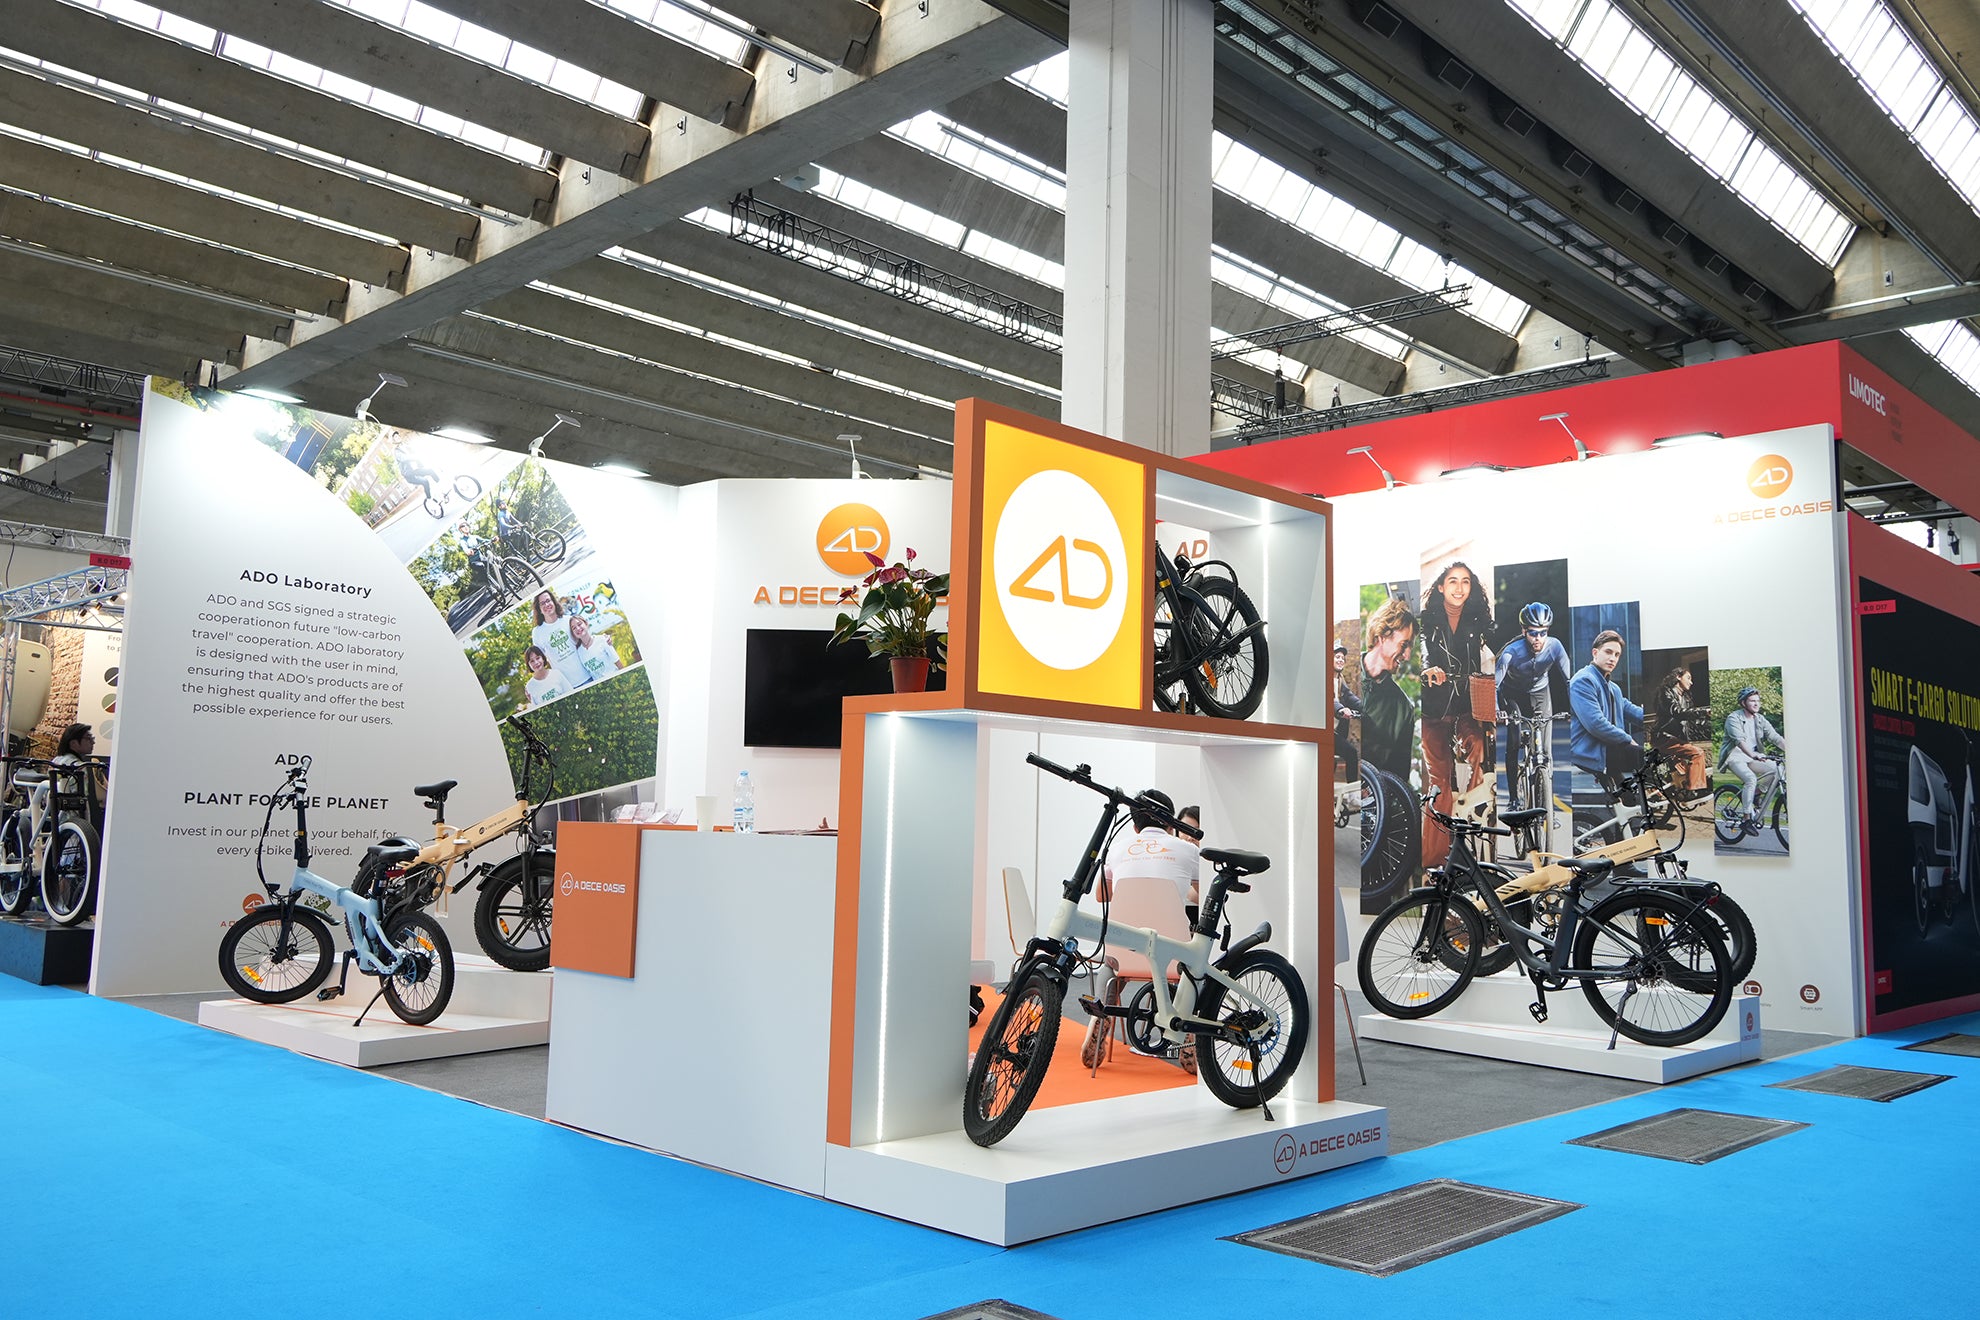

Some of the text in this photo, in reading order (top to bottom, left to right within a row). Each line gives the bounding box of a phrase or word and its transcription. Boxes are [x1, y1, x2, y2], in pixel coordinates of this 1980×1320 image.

[1848, 373, 1886, 417] LIMOTEC
[1714, 500, 1833, 524] A DECE OASIS
[240, 569, 372, 599] ADO Laboratory
[753, 586, 771, 605] A
[779, 586, 859, 605] DECE
[206, 594, 397, 626] ADO and SGS signed a strategic
[198, 612, 401, 642] cooperationon future "low-carbon
[192, 629, 405, 660] travel" cooperation. ADO laboratory
[196, 646, 398, 676] is designed with the user in mind,
[187, 666, 404, 692] ensuring that ADO's products are of
[182, 682, 405, 710] the highest quality and offer the best
[1870, 666, 1903, 713] SMART
[1907, 677, 1945, 723] E-CARGO
[193, 703, 393, 726] possible experience for our users.
[184, 792, 243, 806] PLANT
[327, 796, 390, 810] PLANET
[167, 825, 207, 837] Invest
[210, 825, 222, 837] in
[226, 828, 248, 838] our
[311, 830, 338, 841] your
[341, 828, 379, 840] behalf,
[381, 829, 398, 840] for
[216, 846, 252, 858] every
[574, 880, 580, 890] A
[580, 881, 602, 893] DECE
[602, 882, 626, 895] OASIS
[1299, 1143, 1308, 1158] A
[1310, 1134, 1345, 1155] DECE
[1347, 1126, 1381, 1147] OASIS
